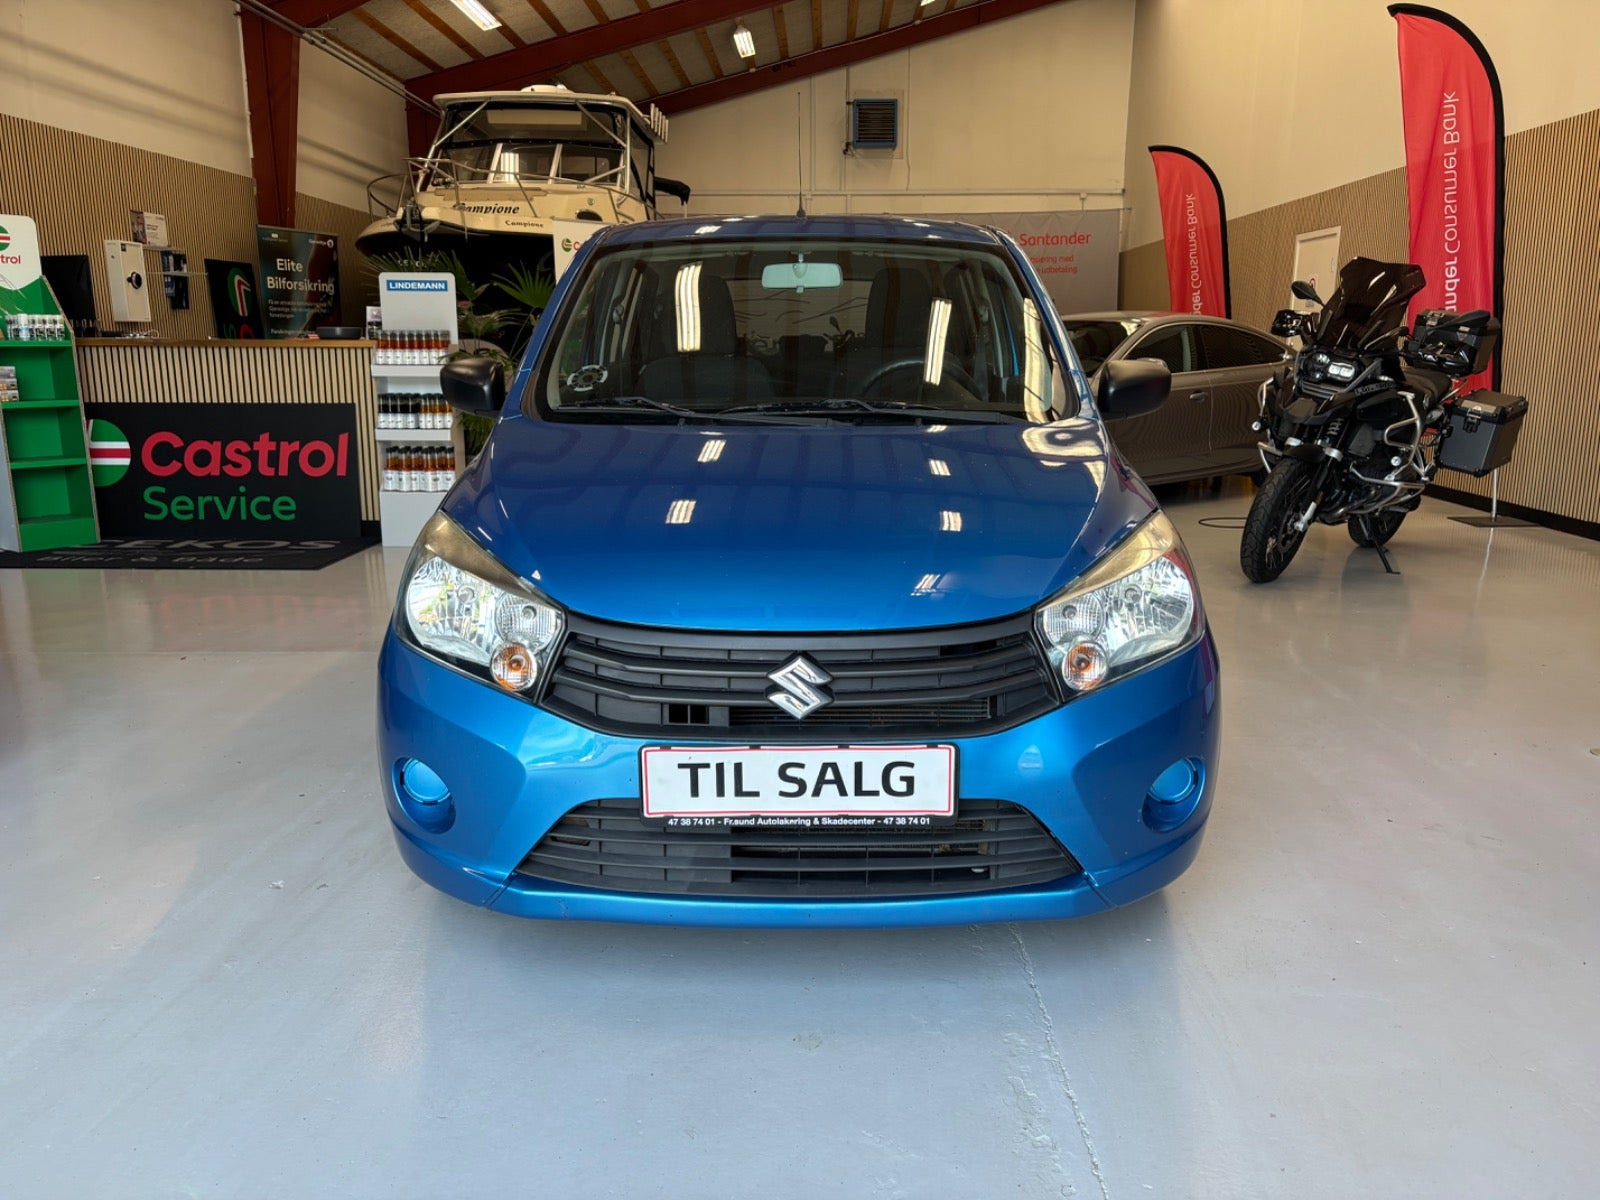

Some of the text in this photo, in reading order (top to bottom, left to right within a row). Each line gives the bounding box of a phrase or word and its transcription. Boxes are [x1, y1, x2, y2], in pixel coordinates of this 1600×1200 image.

[1019, 232, 1092, 247] Santander
[0, 254, 21, 264] trol
[276, 258, 304, 273] Elite
[266, 276, 335, 296] Bilforsikring
[389, 281, 446, 290] LINDEMANN
[141, 431, 349, 478] Castrol
[143, 486, 297, 521] Service
[677, 760, 916, 798] TIL SALG
[668, 818, 678, 826] 47
[680, 818, 691, 826] 38
[693, 818, 703, 826] 74
[705, 818, 715, 826] 01
[757, 817, 811, 827] Autolakering
[813, 817, 820, 826] &
[821, 817, 876, 826] Skadecenter
[883, 817, 894, 825] 47
[895, 817, 906, 825] 38
[908, 817, 918, 825] 74
[919, 817, 930, 825] 01
